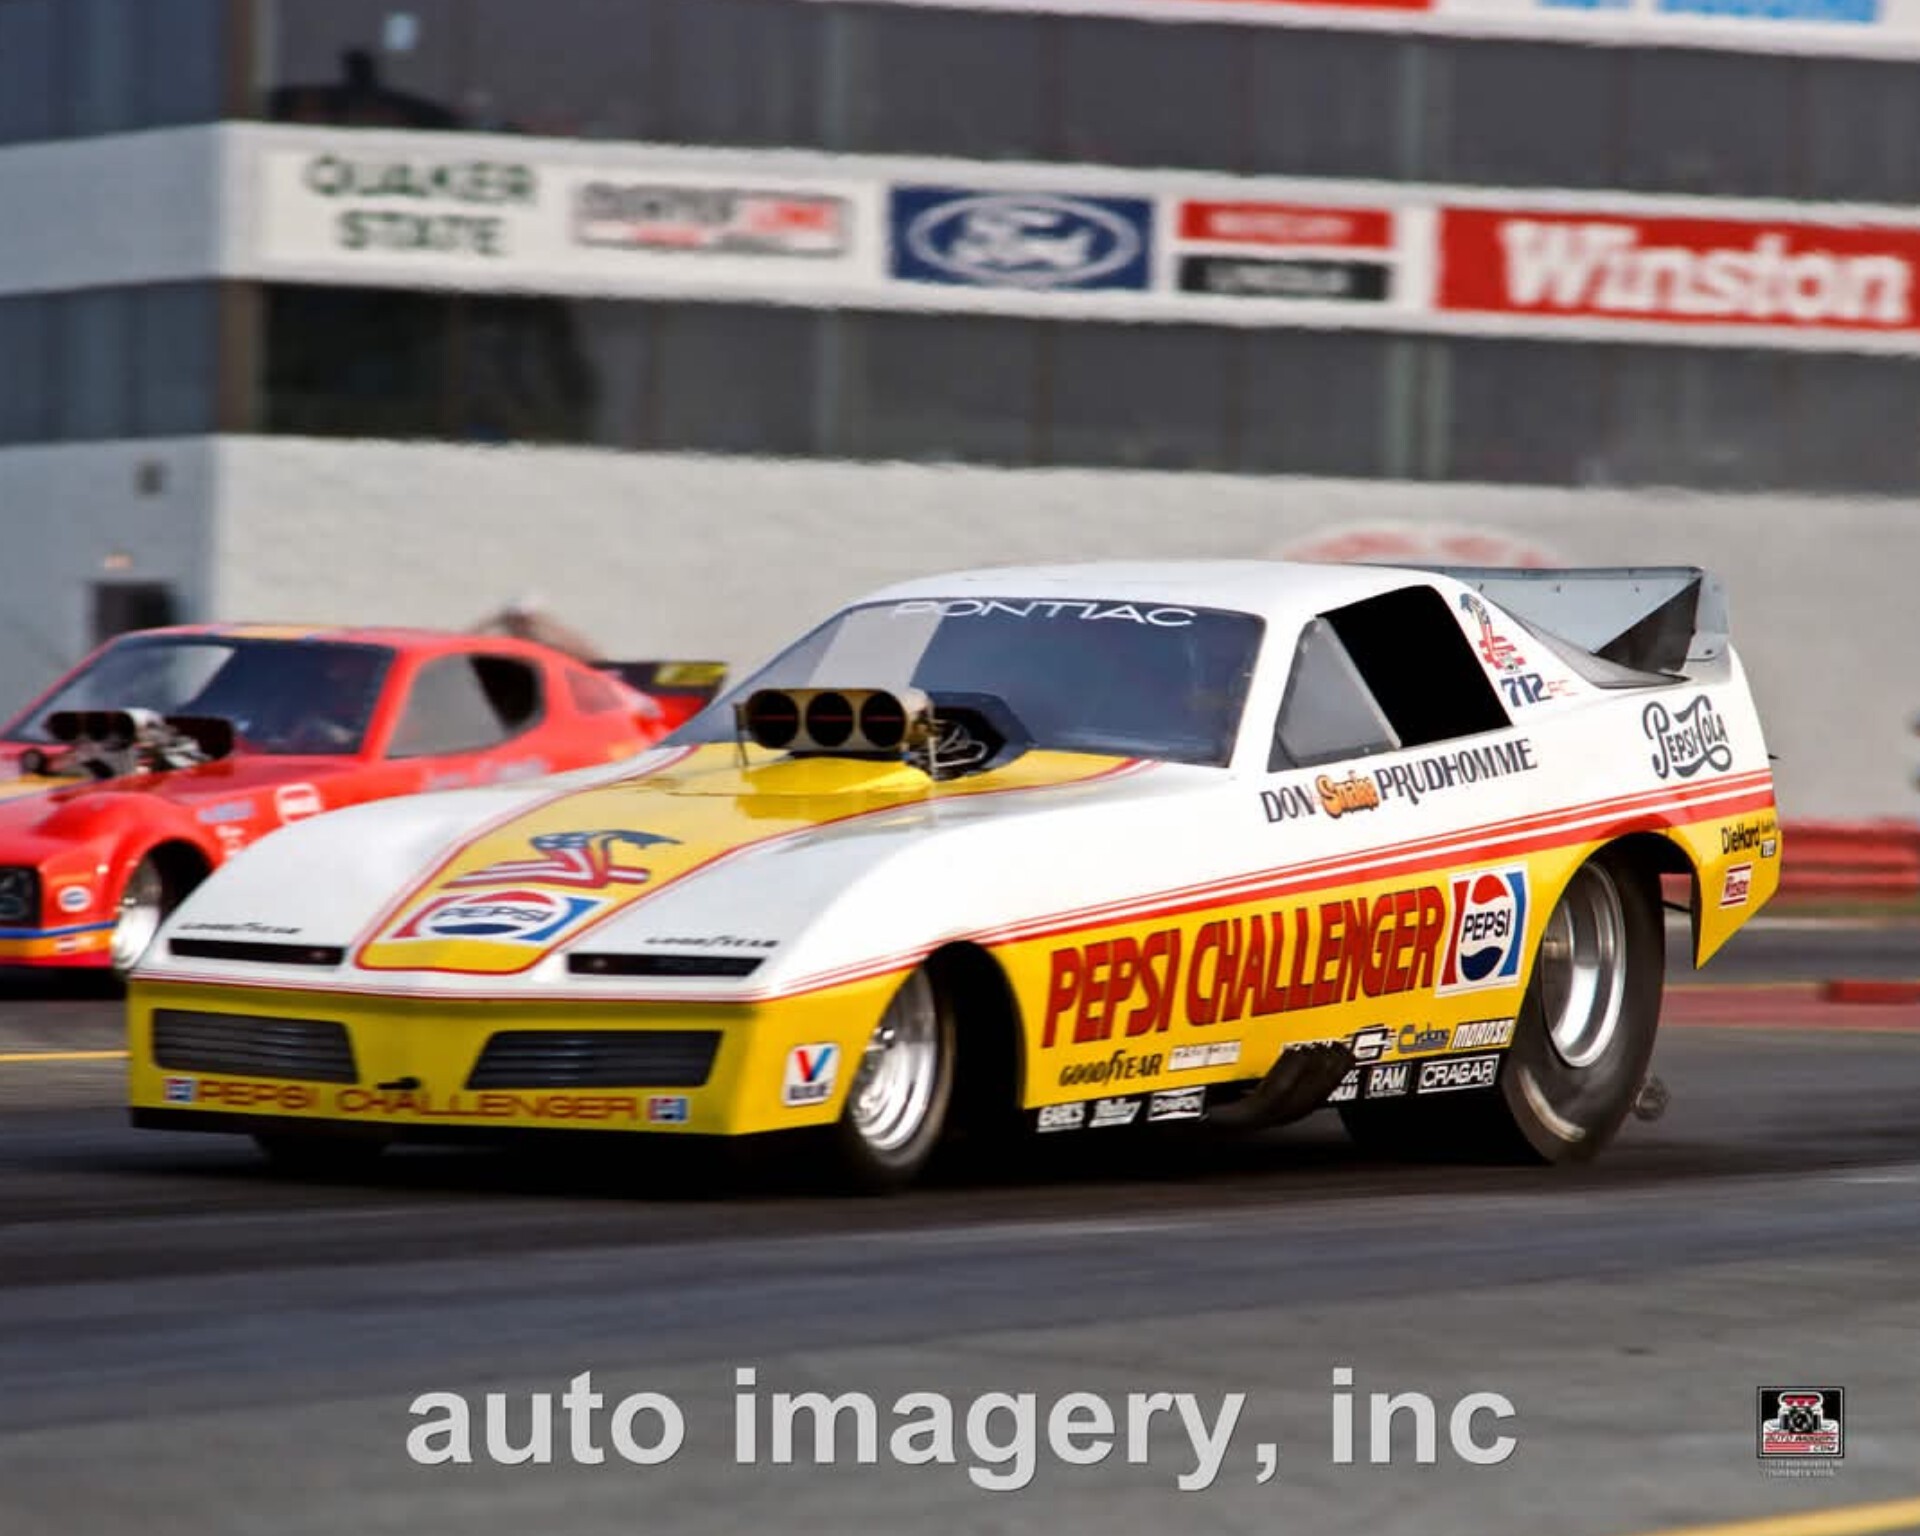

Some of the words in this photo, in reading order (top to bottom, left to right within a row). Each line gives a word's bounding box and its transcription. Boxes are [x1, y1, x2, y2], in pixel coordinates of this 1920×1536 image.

[304, 155, 538, 204] QUAKER
[335, 210, 508, 257] STATE
[1500, 219, 1911, 323] Winston
[892, 599, 1198, 627] PONTIAC
[1499, 673, 1553, 708] 712
[1260, 782, 1316, 823] DON
[1374, 738, 1538, 805] PRUDHOMME
[1721, 822, 1760, 855] DieHard
[430, 906, 554, 923] PEPSI
[1460, 908, 1512, 943] PEPSI
[1042, 927, 1182, 1049] PEPSI
[1184, 886, 1447, 1027] CHALLENGER
[1059, 1049, 1164, 1087] GOODYEAR
[1370, 1066, 1408, 1091] RAM
[199, 1079, 320, 1110] PEPSI
[334, 1088, 638, 1121] CHALLENGER
